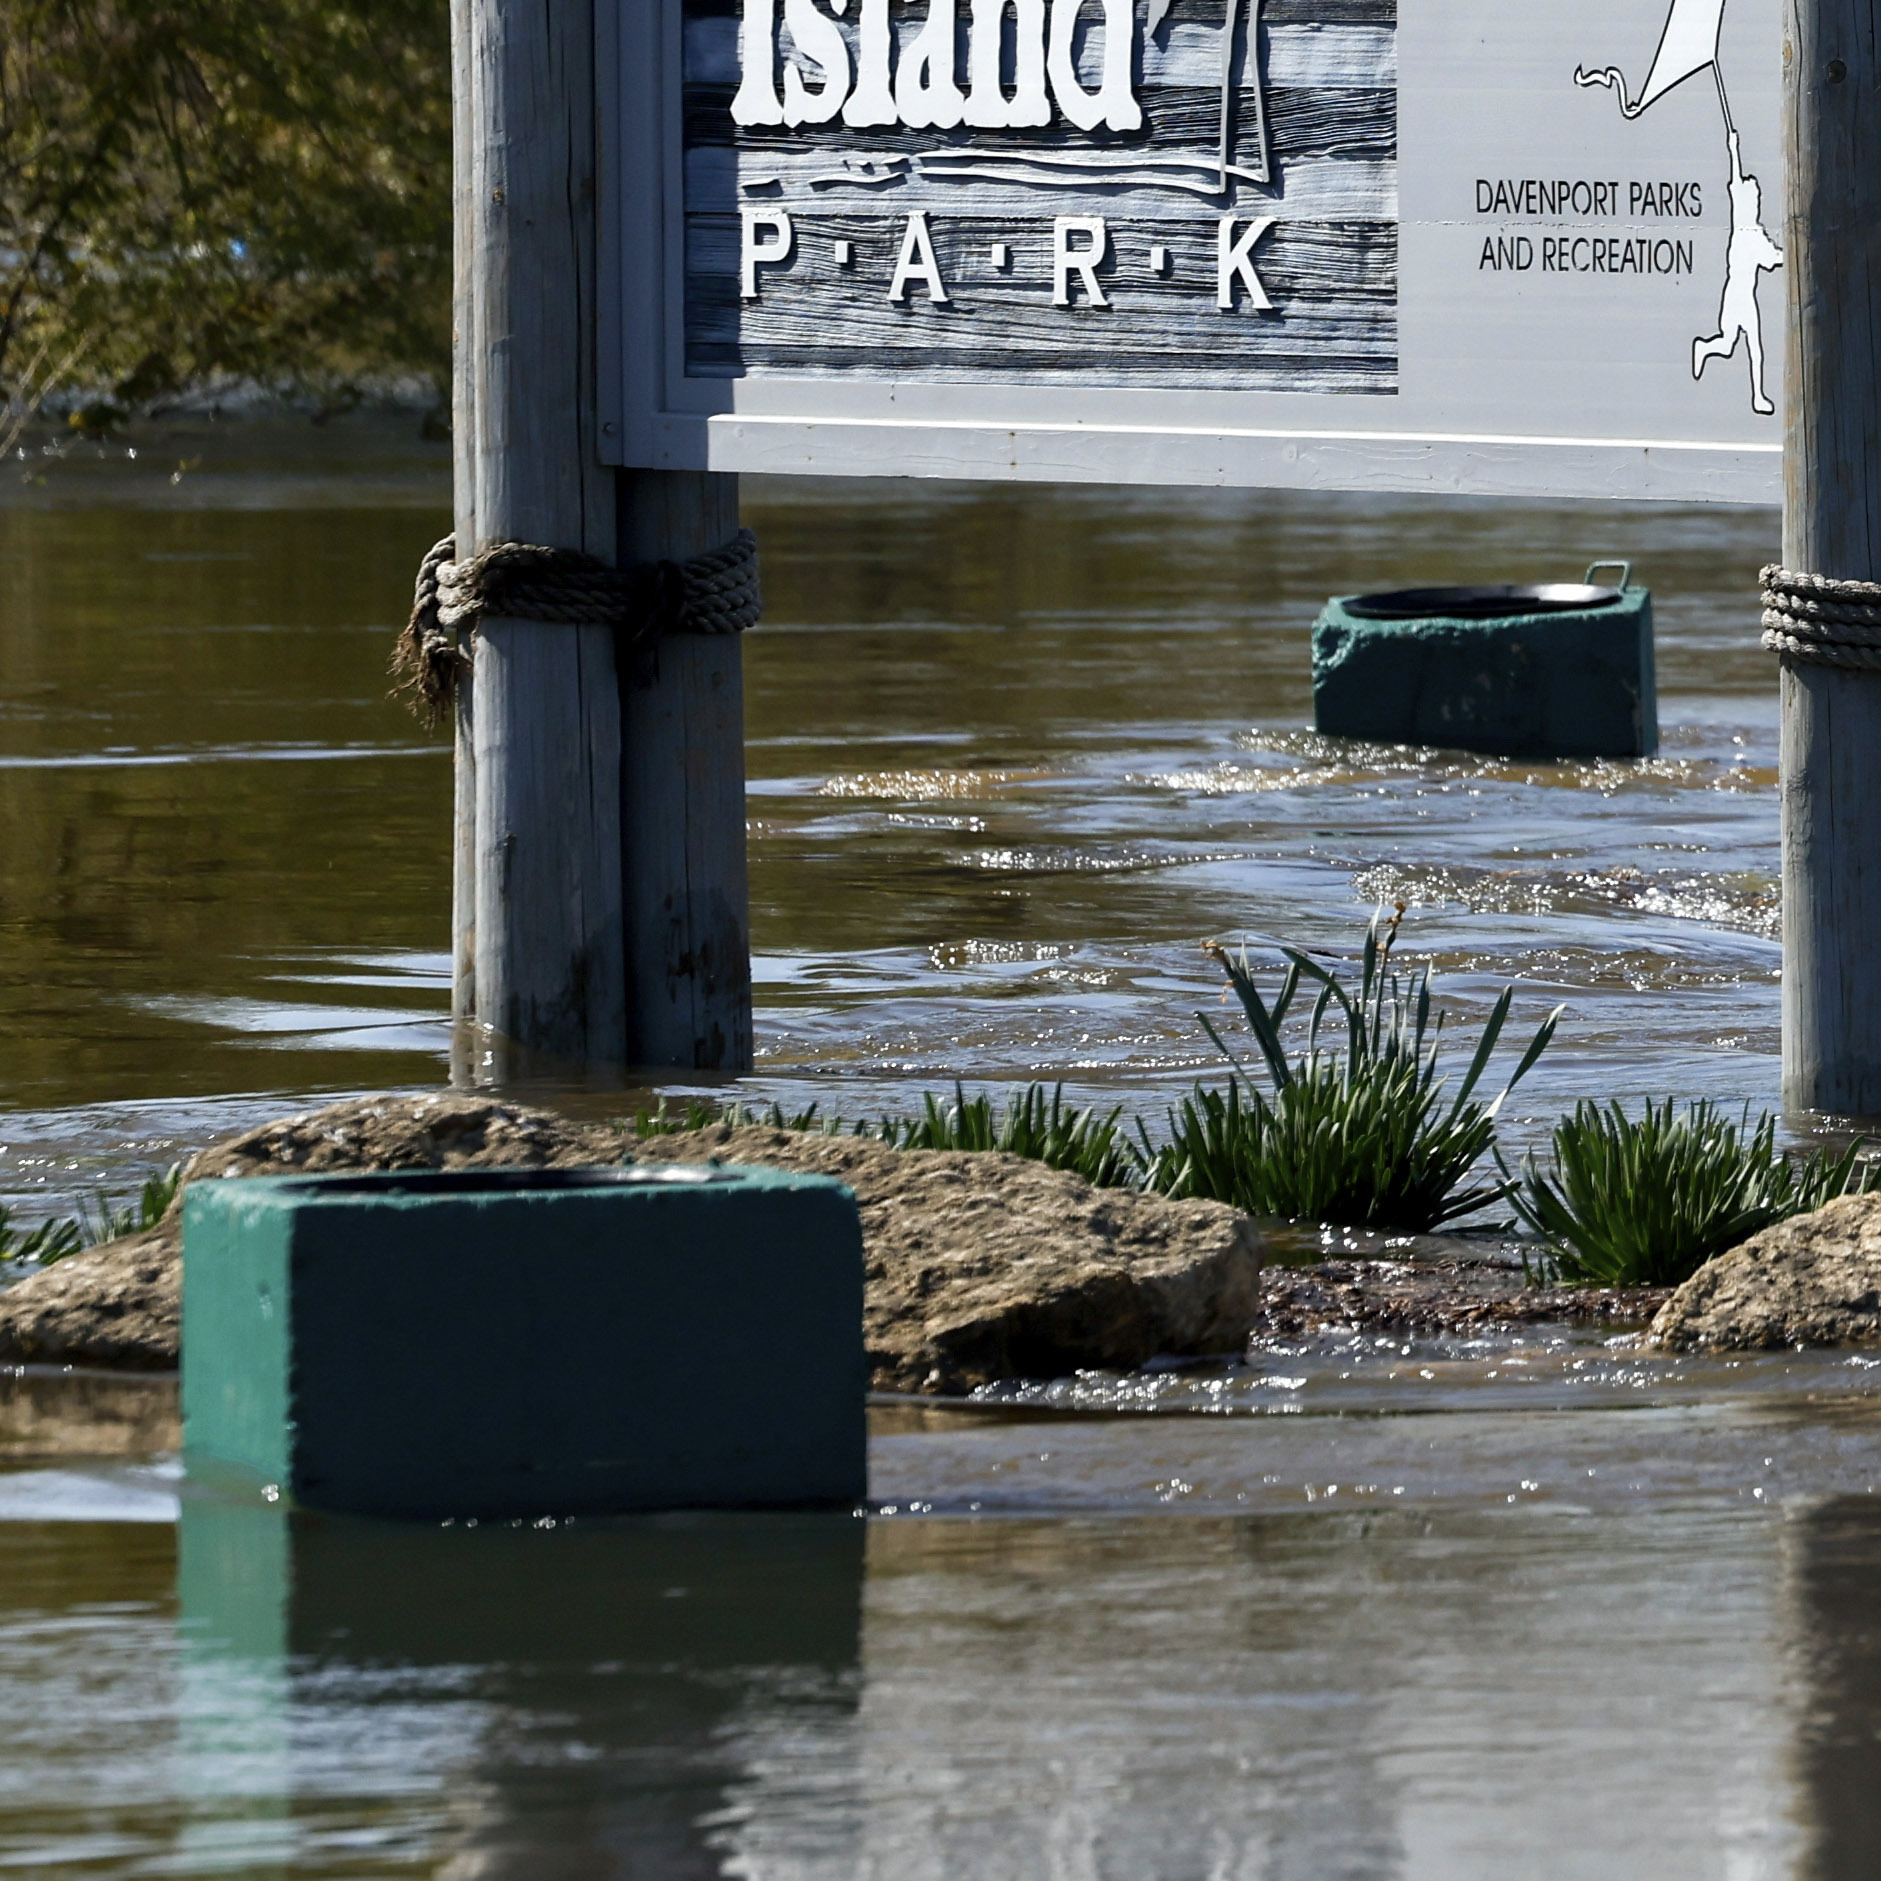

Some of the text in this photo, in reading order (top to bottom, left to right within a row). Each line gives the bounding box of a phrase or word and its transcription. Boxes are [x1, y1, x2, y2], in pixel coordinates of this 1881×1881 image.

[1475, 178, 1703, 218] DAVENPORT PARKS
[1479, 236, 1694, 276] AND RECREATION
